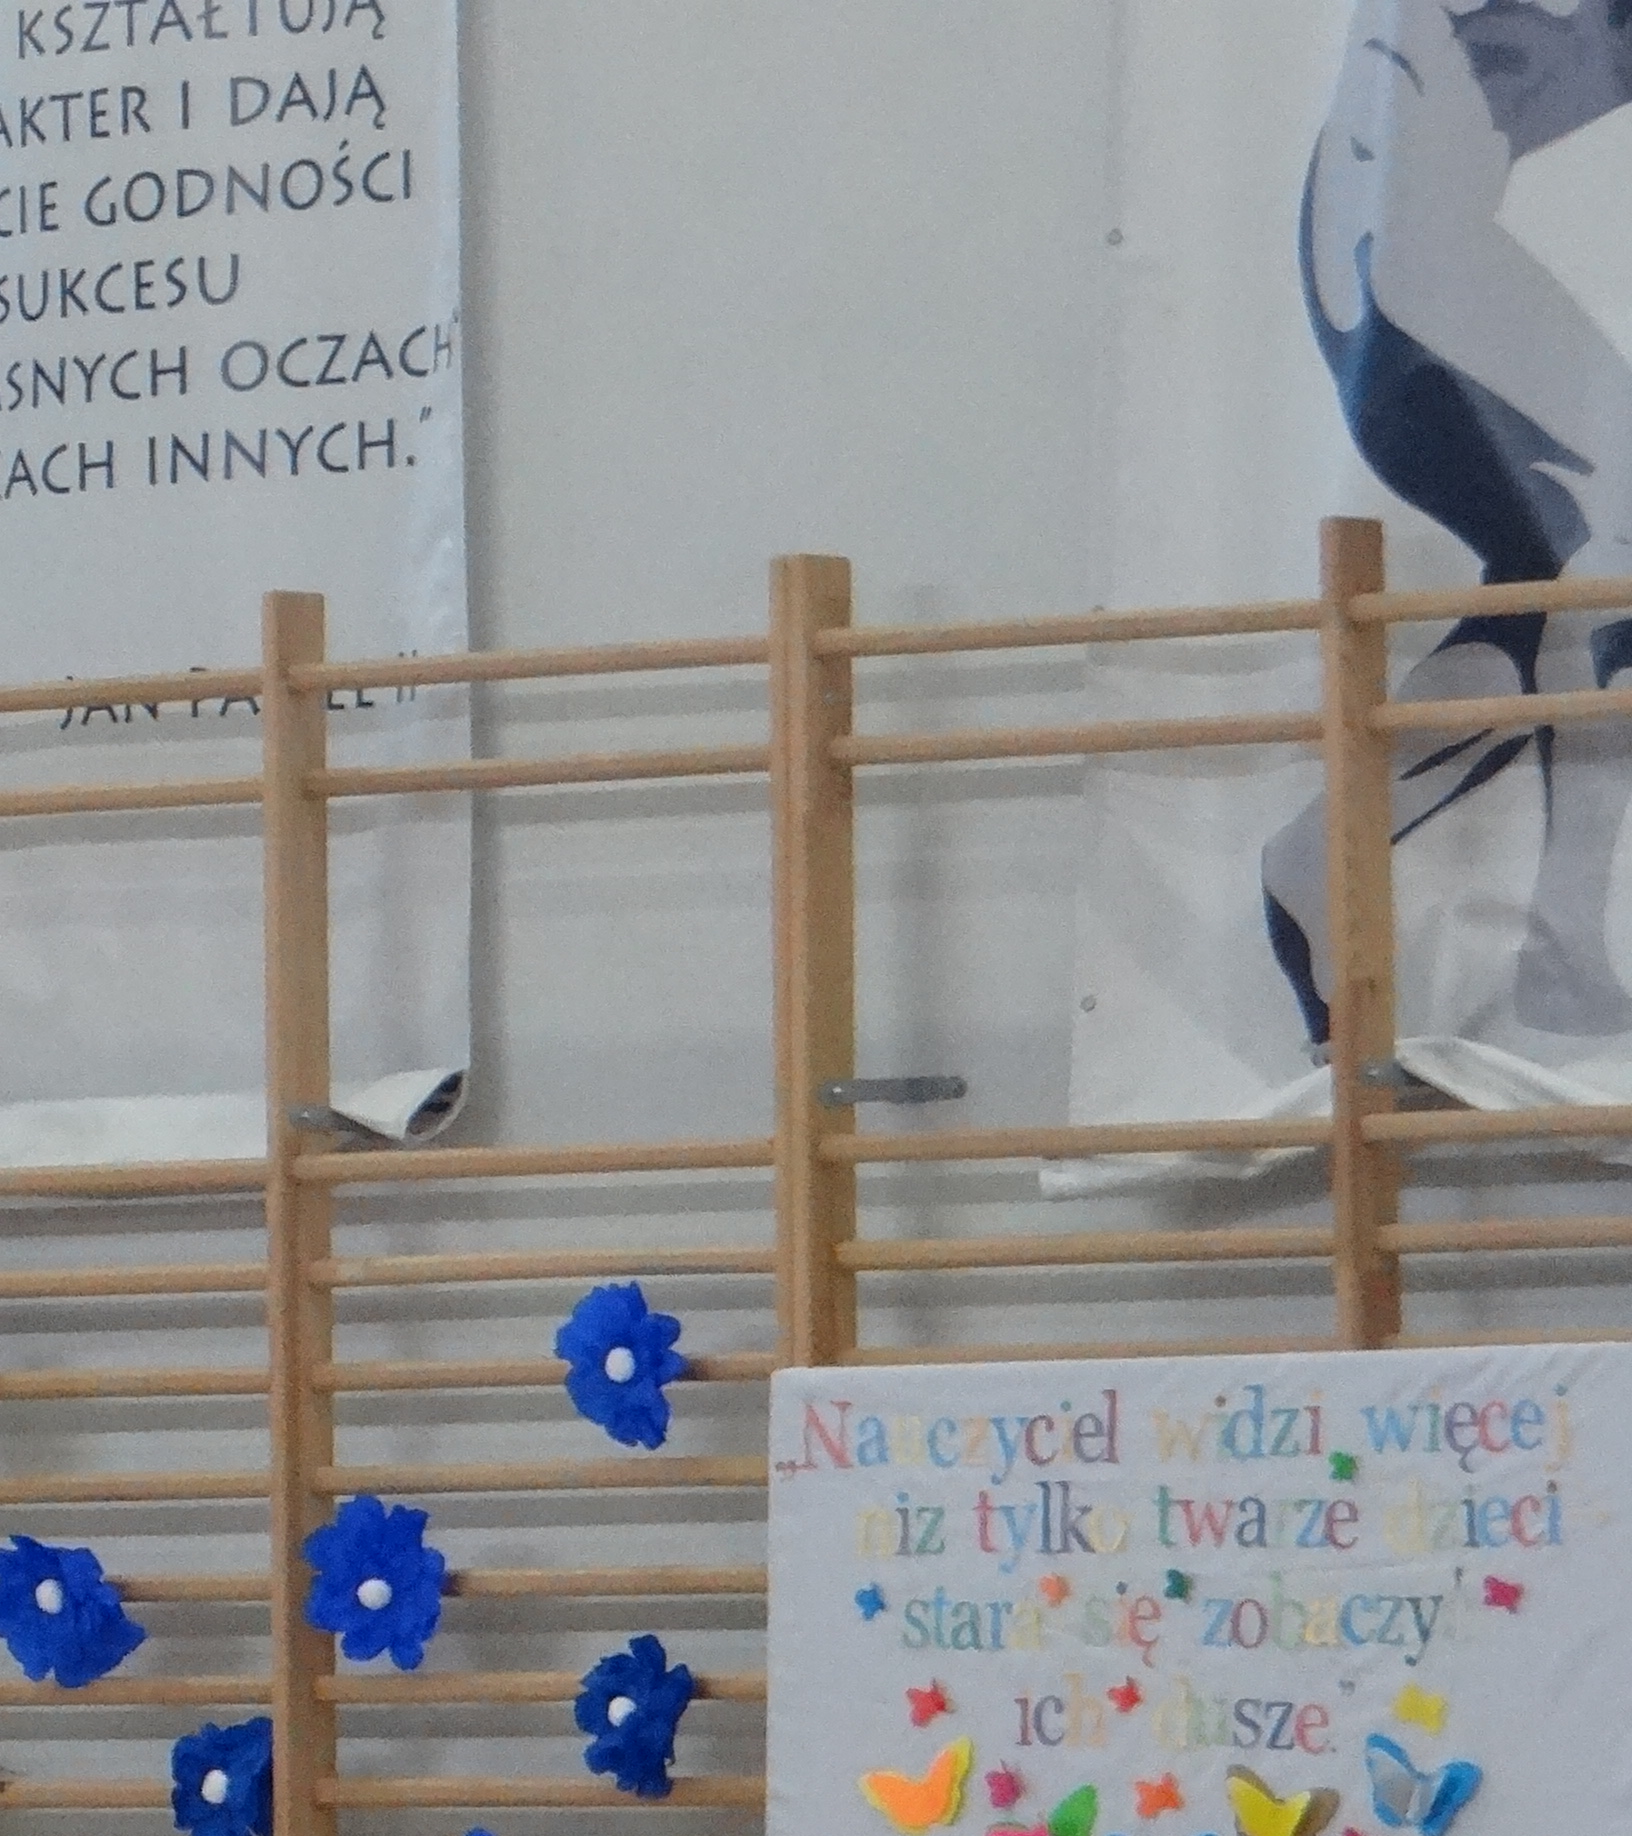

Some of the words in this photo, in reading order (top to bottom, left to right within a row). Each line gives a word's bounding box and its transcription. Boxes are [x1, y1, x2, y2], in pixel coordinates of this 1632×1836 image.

[180, 80, 190, 130] I
[229, 64, 387, 130] DAJĄ
[84, 139, 413, 227] GODNOŚCI
[1151, 1383, 1325, 1464] widzi
[1359, 1383, 1576, 1474] więcej
[972, 1480, 1133, 1575] tylko
[1154, 1483, 1360, 1551] twarze
[1381, 1476, 1565, 1555] dzieci
[901, 1585, 1044, 1651] stara
[1082, 1579, 1163, 1669] się
[1013, 1671, 1109, 1748] ich
